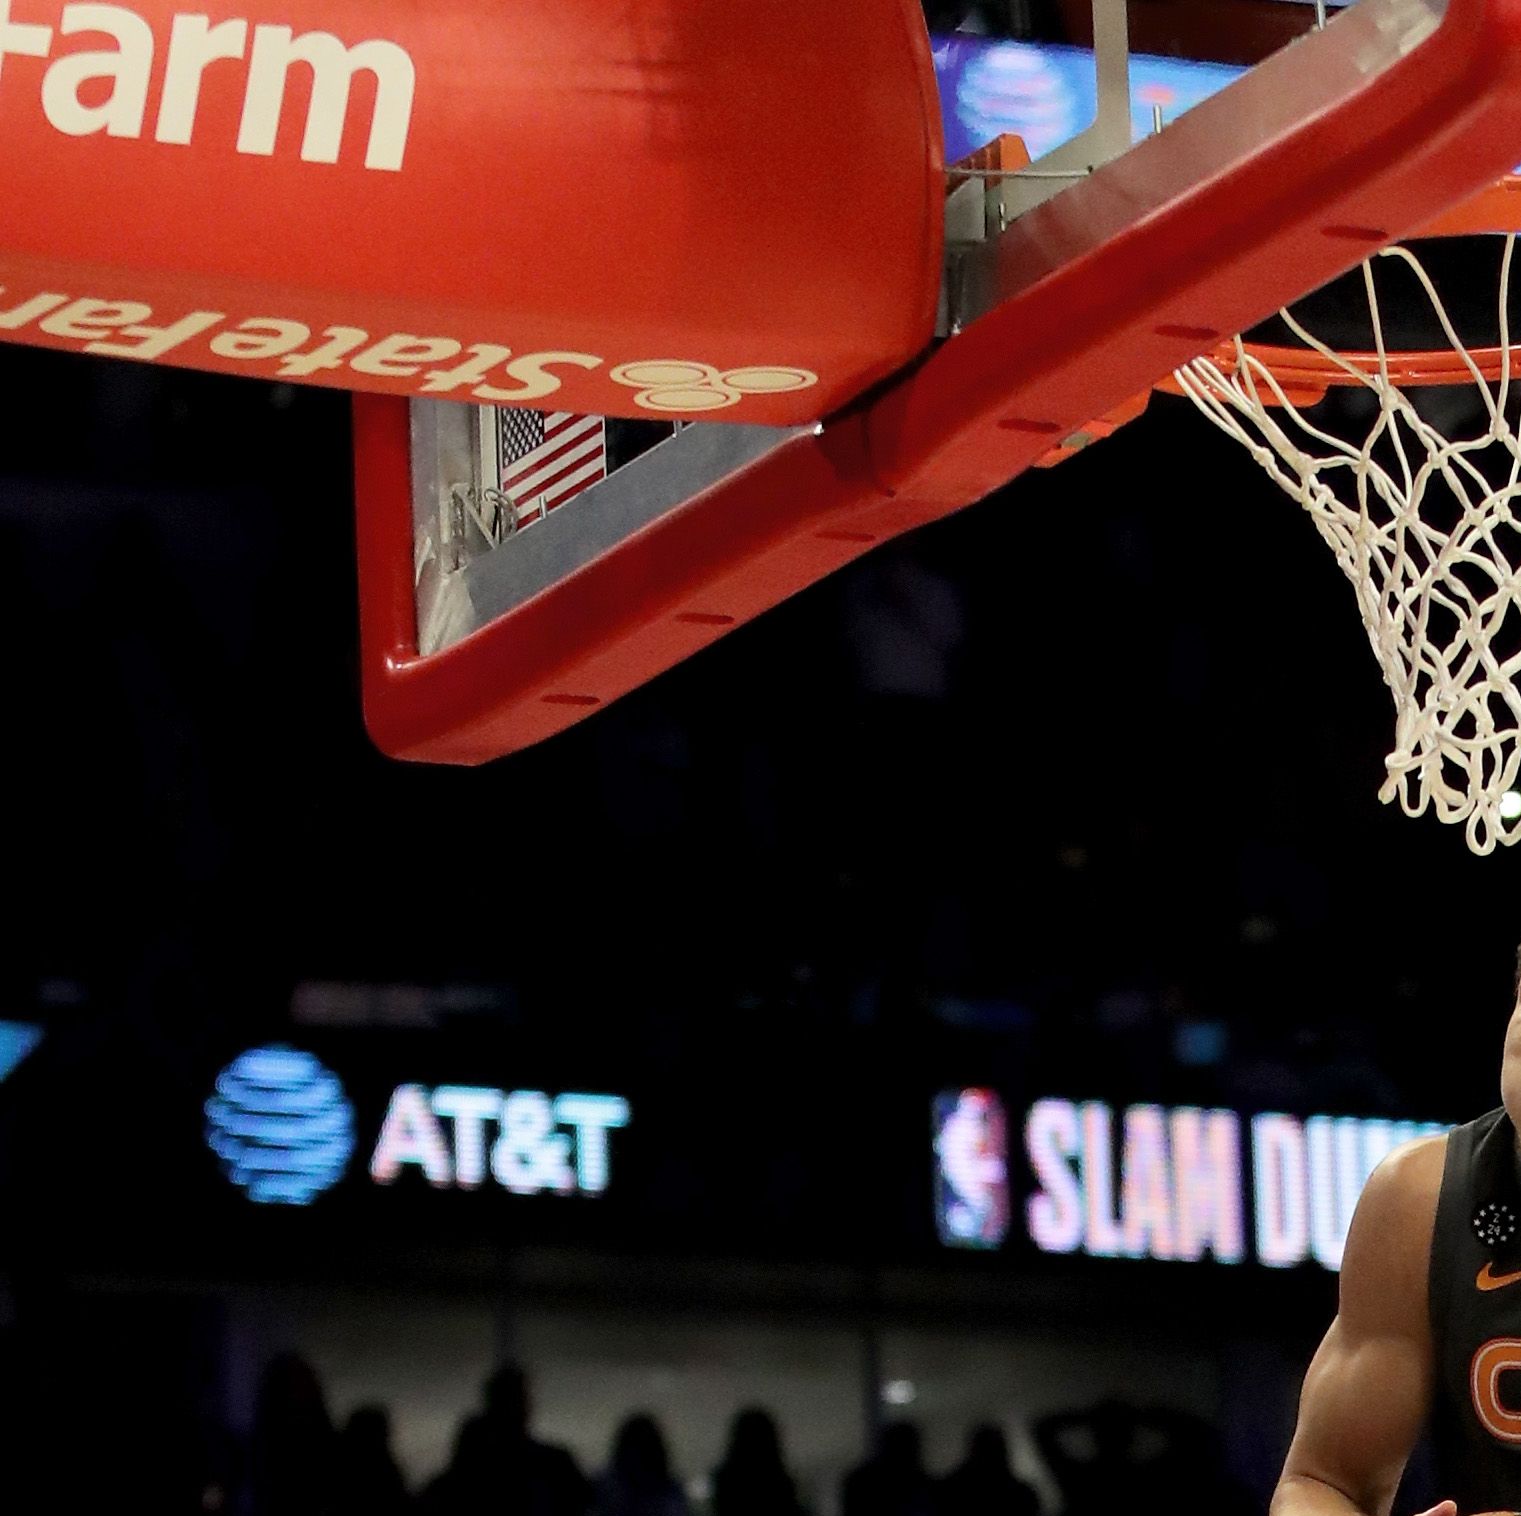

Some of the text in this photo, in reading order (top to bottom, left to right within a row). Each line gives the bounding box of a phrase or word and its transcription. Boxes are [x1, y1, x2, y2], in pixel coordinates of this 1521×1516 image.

[370, 1083, 630, 1197] AT&T
[1025, 1098, 1456, 1272] SLAM DU
